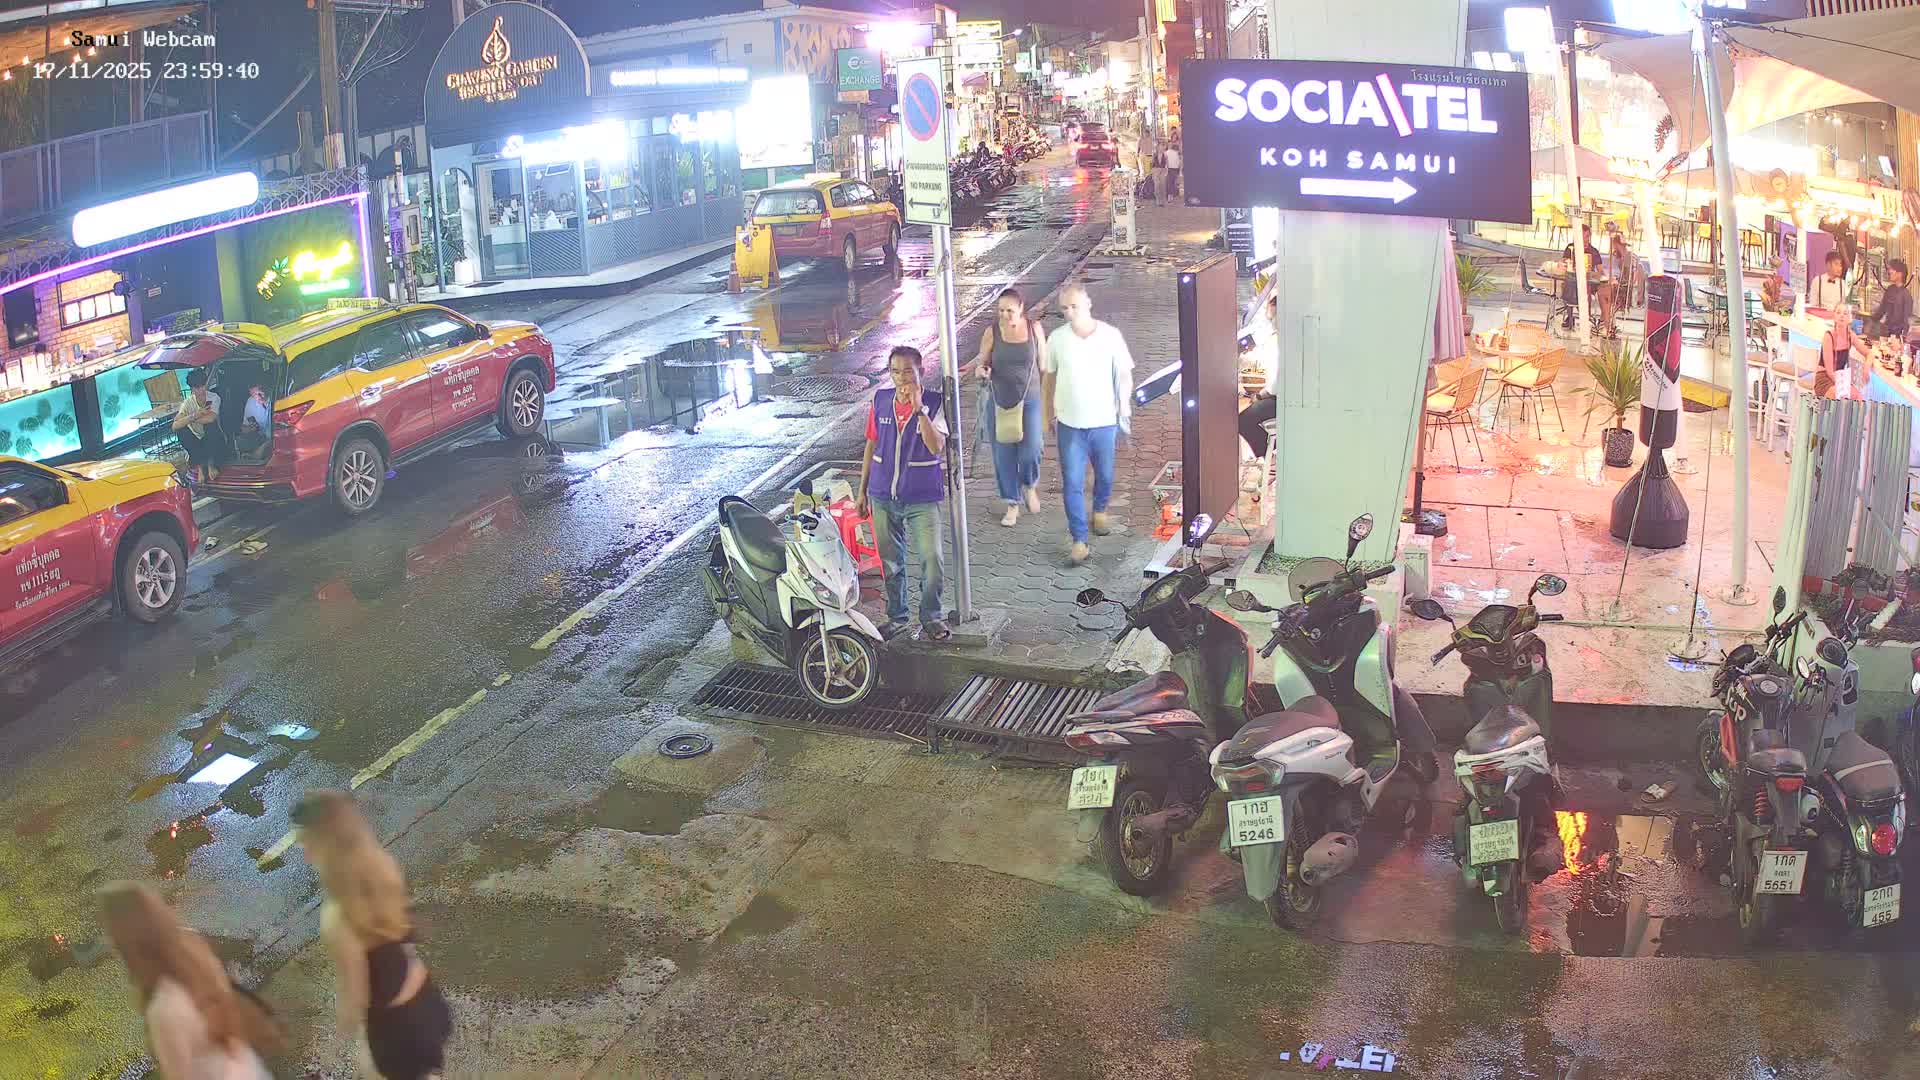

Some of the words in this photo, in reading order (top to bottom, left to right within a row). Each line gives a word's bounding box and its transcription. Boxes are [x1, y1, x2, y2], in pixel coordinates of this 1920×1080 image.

[840, 75, 880, 86] EXCHANGE
[1260, 147, 1328, 168] KOH
[1346, 151, 1456, 174] SAMUI
[910, 181, 918, 189] NO
[918, 181, 942, 191] PARKING
[1239, 815, 1274, 827] สุราษฎร์ธานี
[1239, 828, 1275, 842] 5246
[1764, 880, 1793, 890] 5651
[1871, 909, 1893, 924] 455
